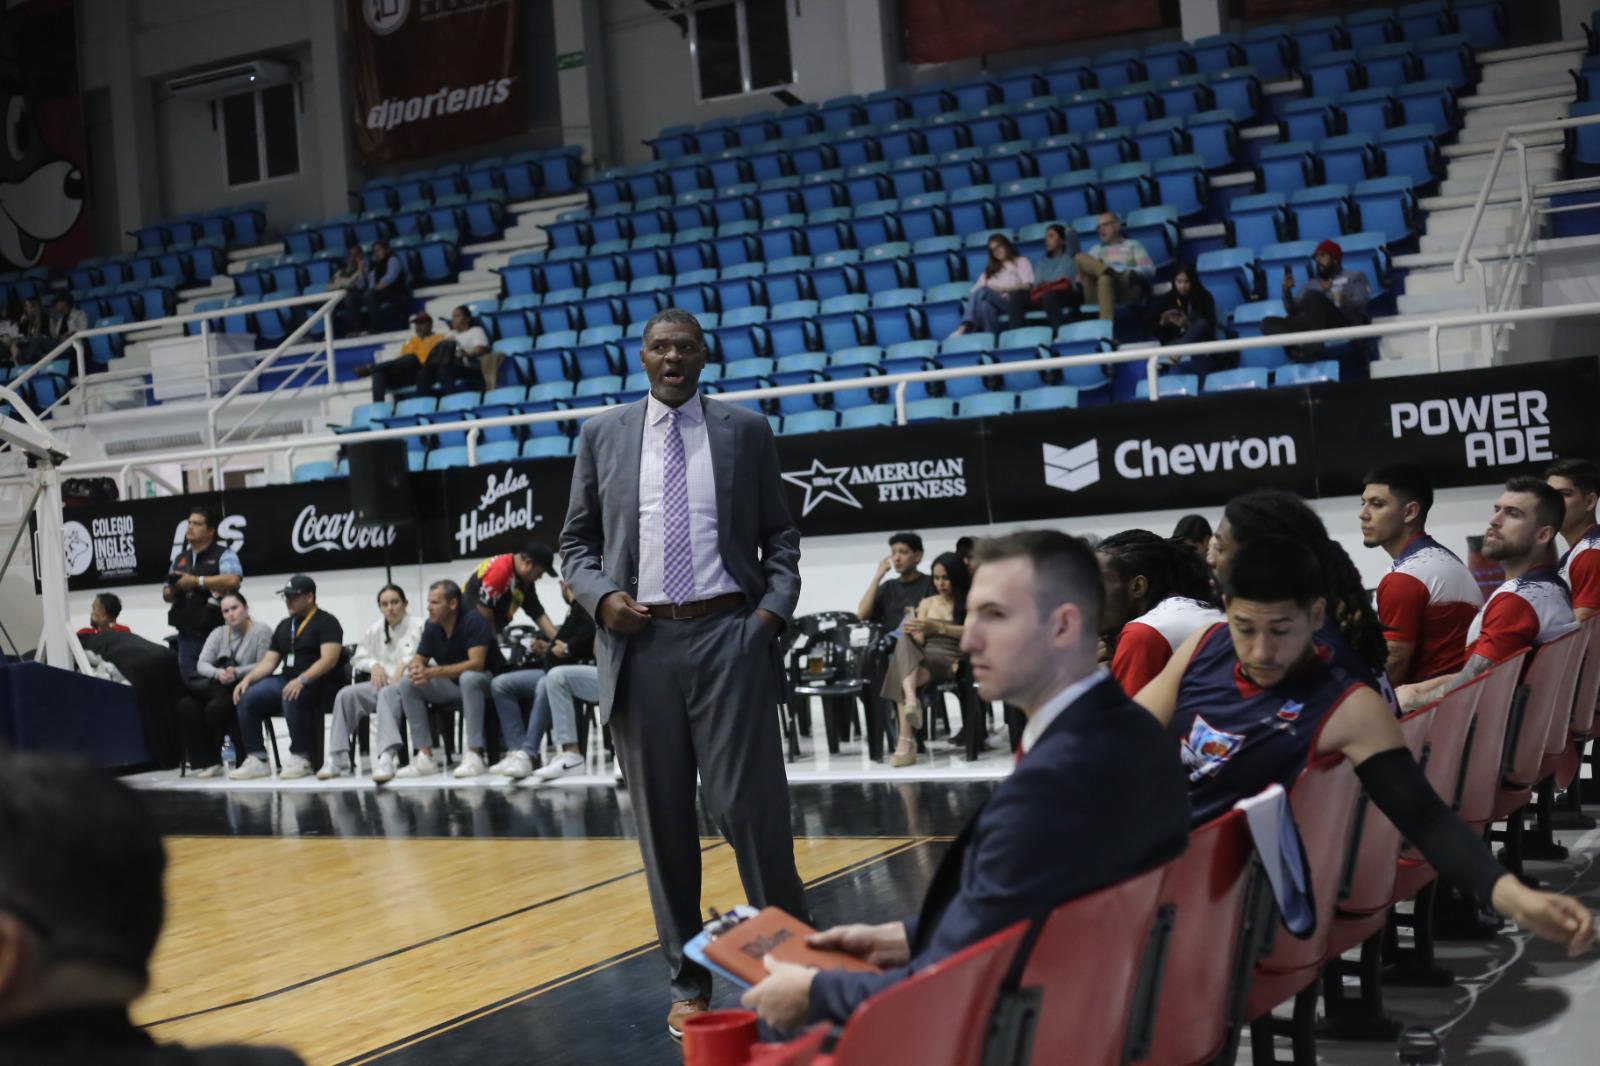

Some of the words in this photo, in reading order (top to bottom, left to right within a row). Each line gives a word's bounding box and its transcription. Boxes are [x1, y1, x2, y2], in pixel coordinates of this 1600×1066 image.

[366, 78, 512, 130] dportenis
[1390, 389, 1550, 438] POWER
[1114, 434, 1297, 479] Chevron
[1465, 426, 1553, 468] ADE
[478, 467, 530, 511] Salsa
[849, 457, 964, 485] AMERICAN
[878, 478, 967, 502] FITNESS
[92, 514, 134, 537] COLEGIO
[455, 488, 535, 555] Huichol
